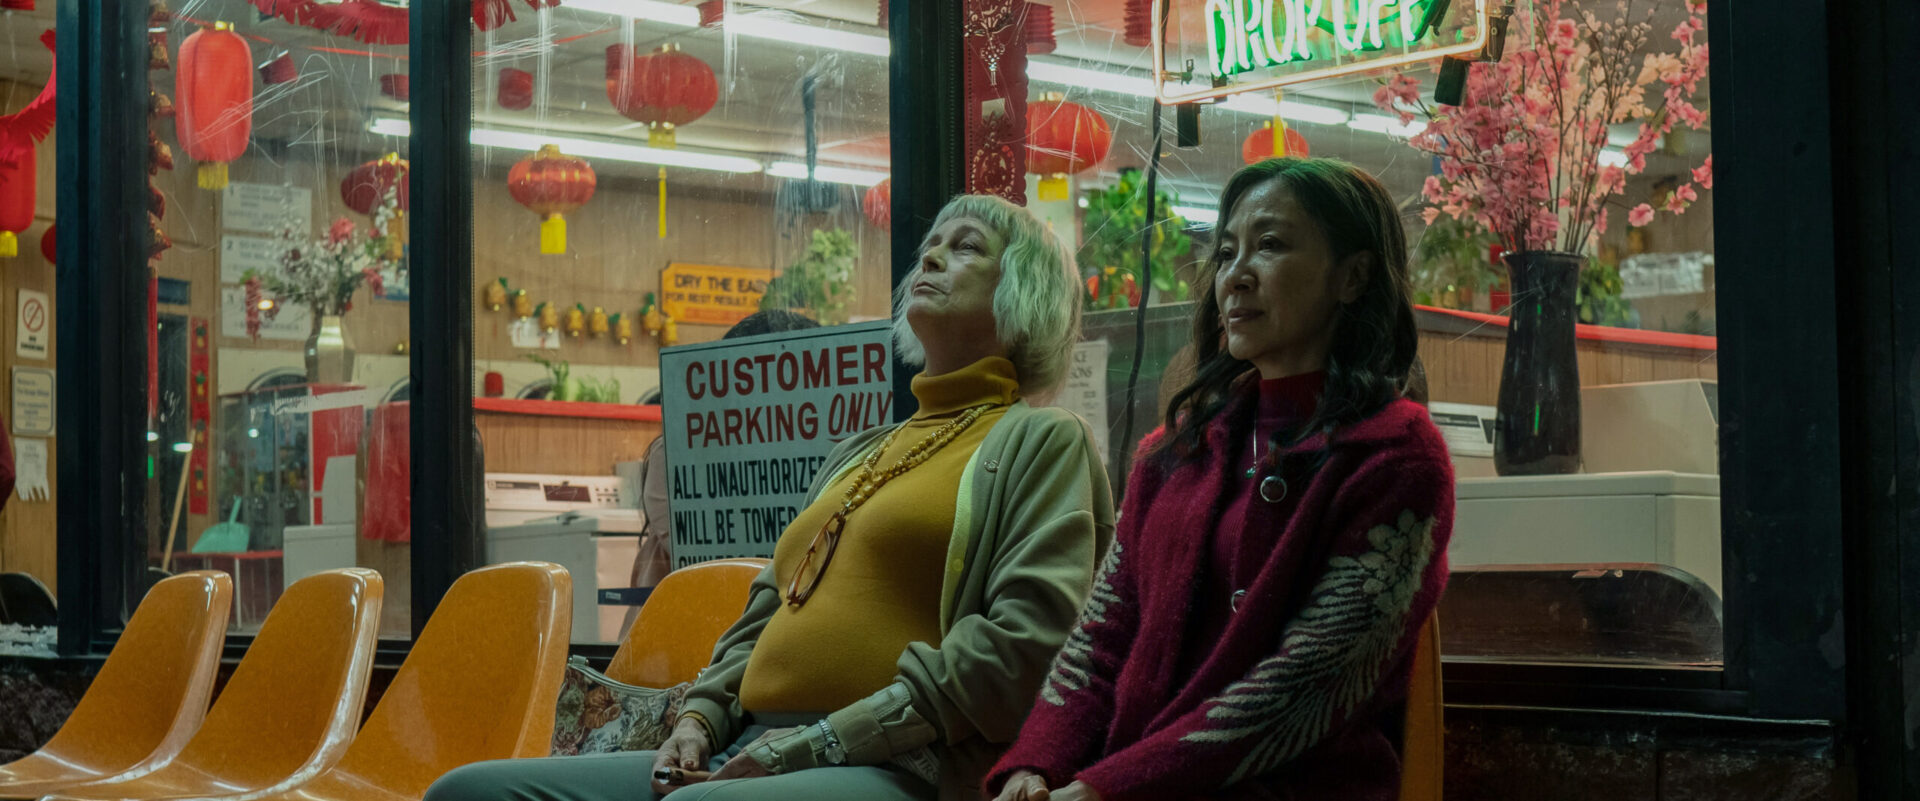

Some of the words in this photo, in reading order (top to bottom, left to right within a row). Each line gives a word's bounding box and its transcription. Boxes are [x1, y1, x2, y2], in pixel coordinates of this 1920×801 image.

[1205, 0, 1321, 76] DROP
[1332, 0, 1417, 50] OFF
[675, 274, 702, 289] DRY
[707, 277, 732, 292] THE
[738, 279, 770, 293] EAS
[686, 343, 887, 400] CUSTOMER
[686, 401, 818, 449] PARKING
[828, 391, 894, 436] ONLY
[674, 464, 702, 500] ALL
[675, 510, 712, 545] WILL
[715, 509, 736, 545] BE
